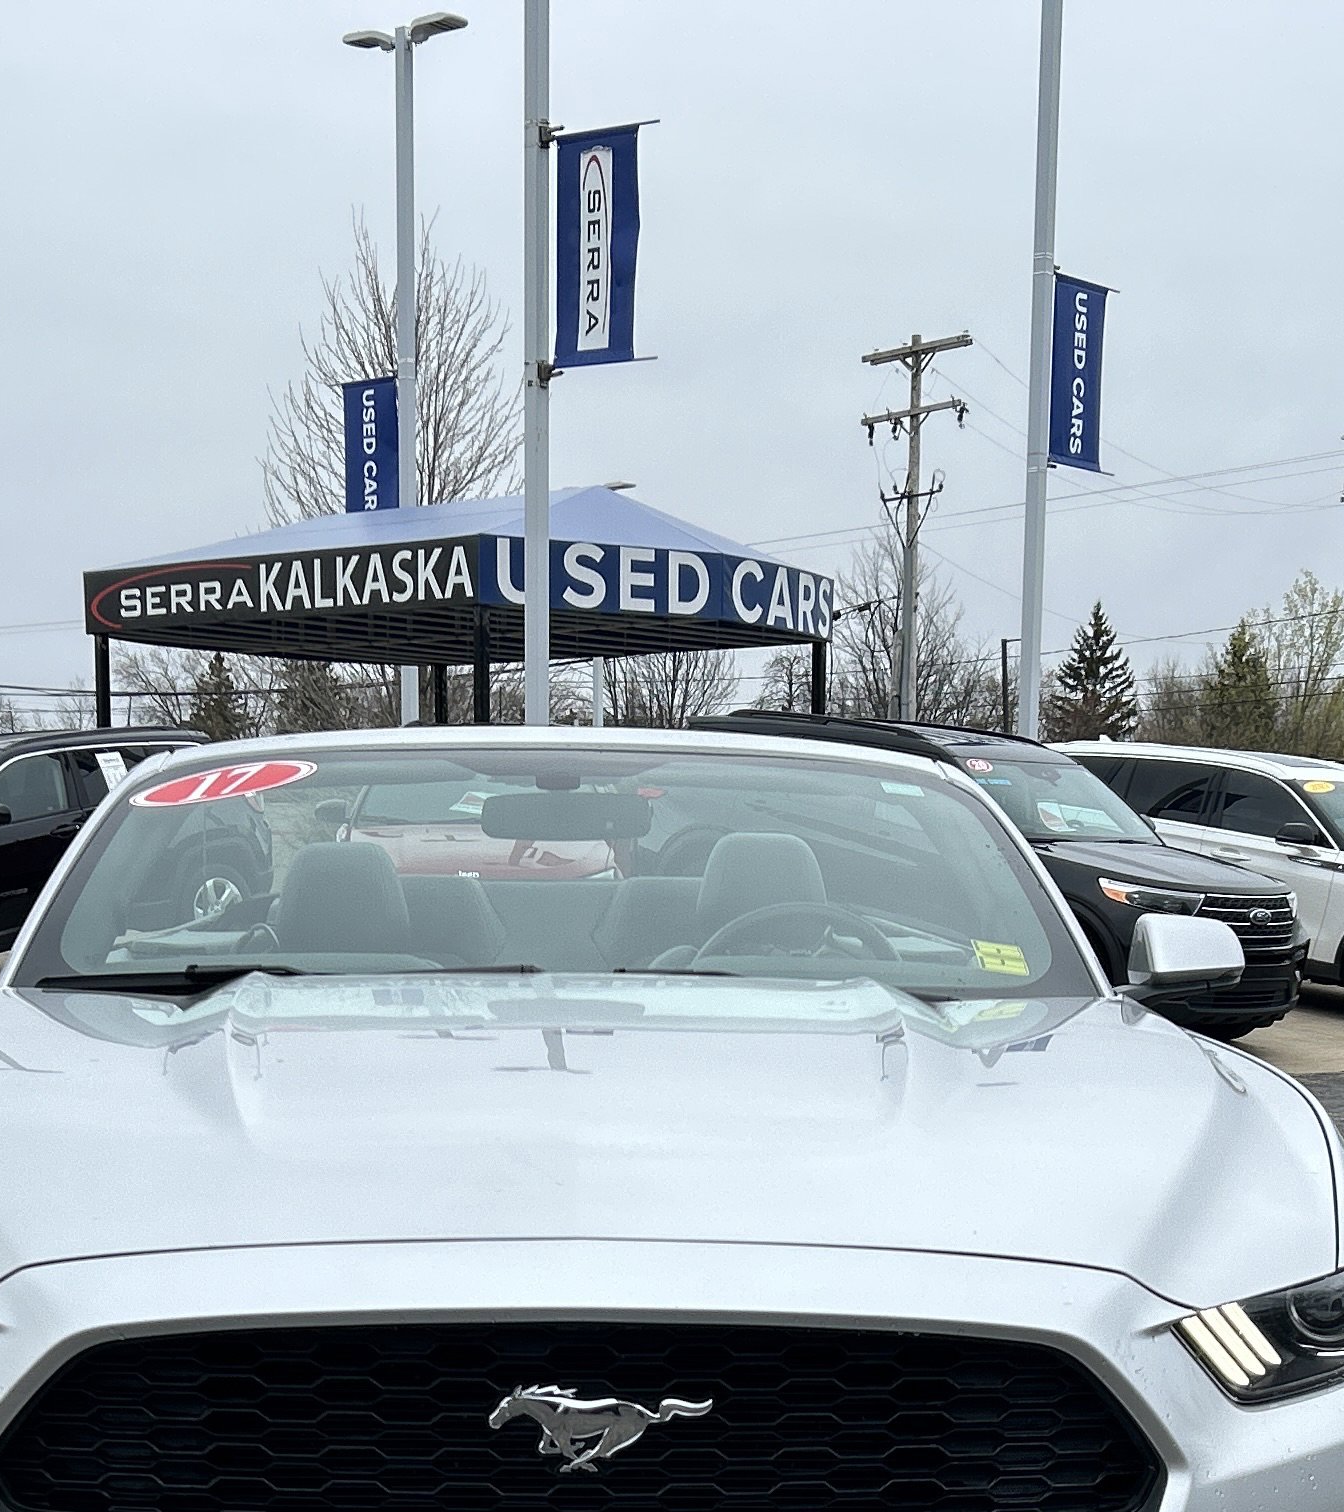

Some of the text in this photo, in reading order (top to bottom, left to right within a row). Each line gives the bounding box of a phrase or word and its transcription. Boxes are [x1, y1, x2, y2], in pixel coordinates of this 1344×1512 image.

[586, 188, 602, 338] SERRA
[1069, 292, 1088, 454] USED CARS
[361, 389, 379, 511] USED CAR
[119, 545, 474, 618] SERRA KALKASKA
[496, 538, 832, 639] USED CARS
[185, 764, 267, 801] 17
